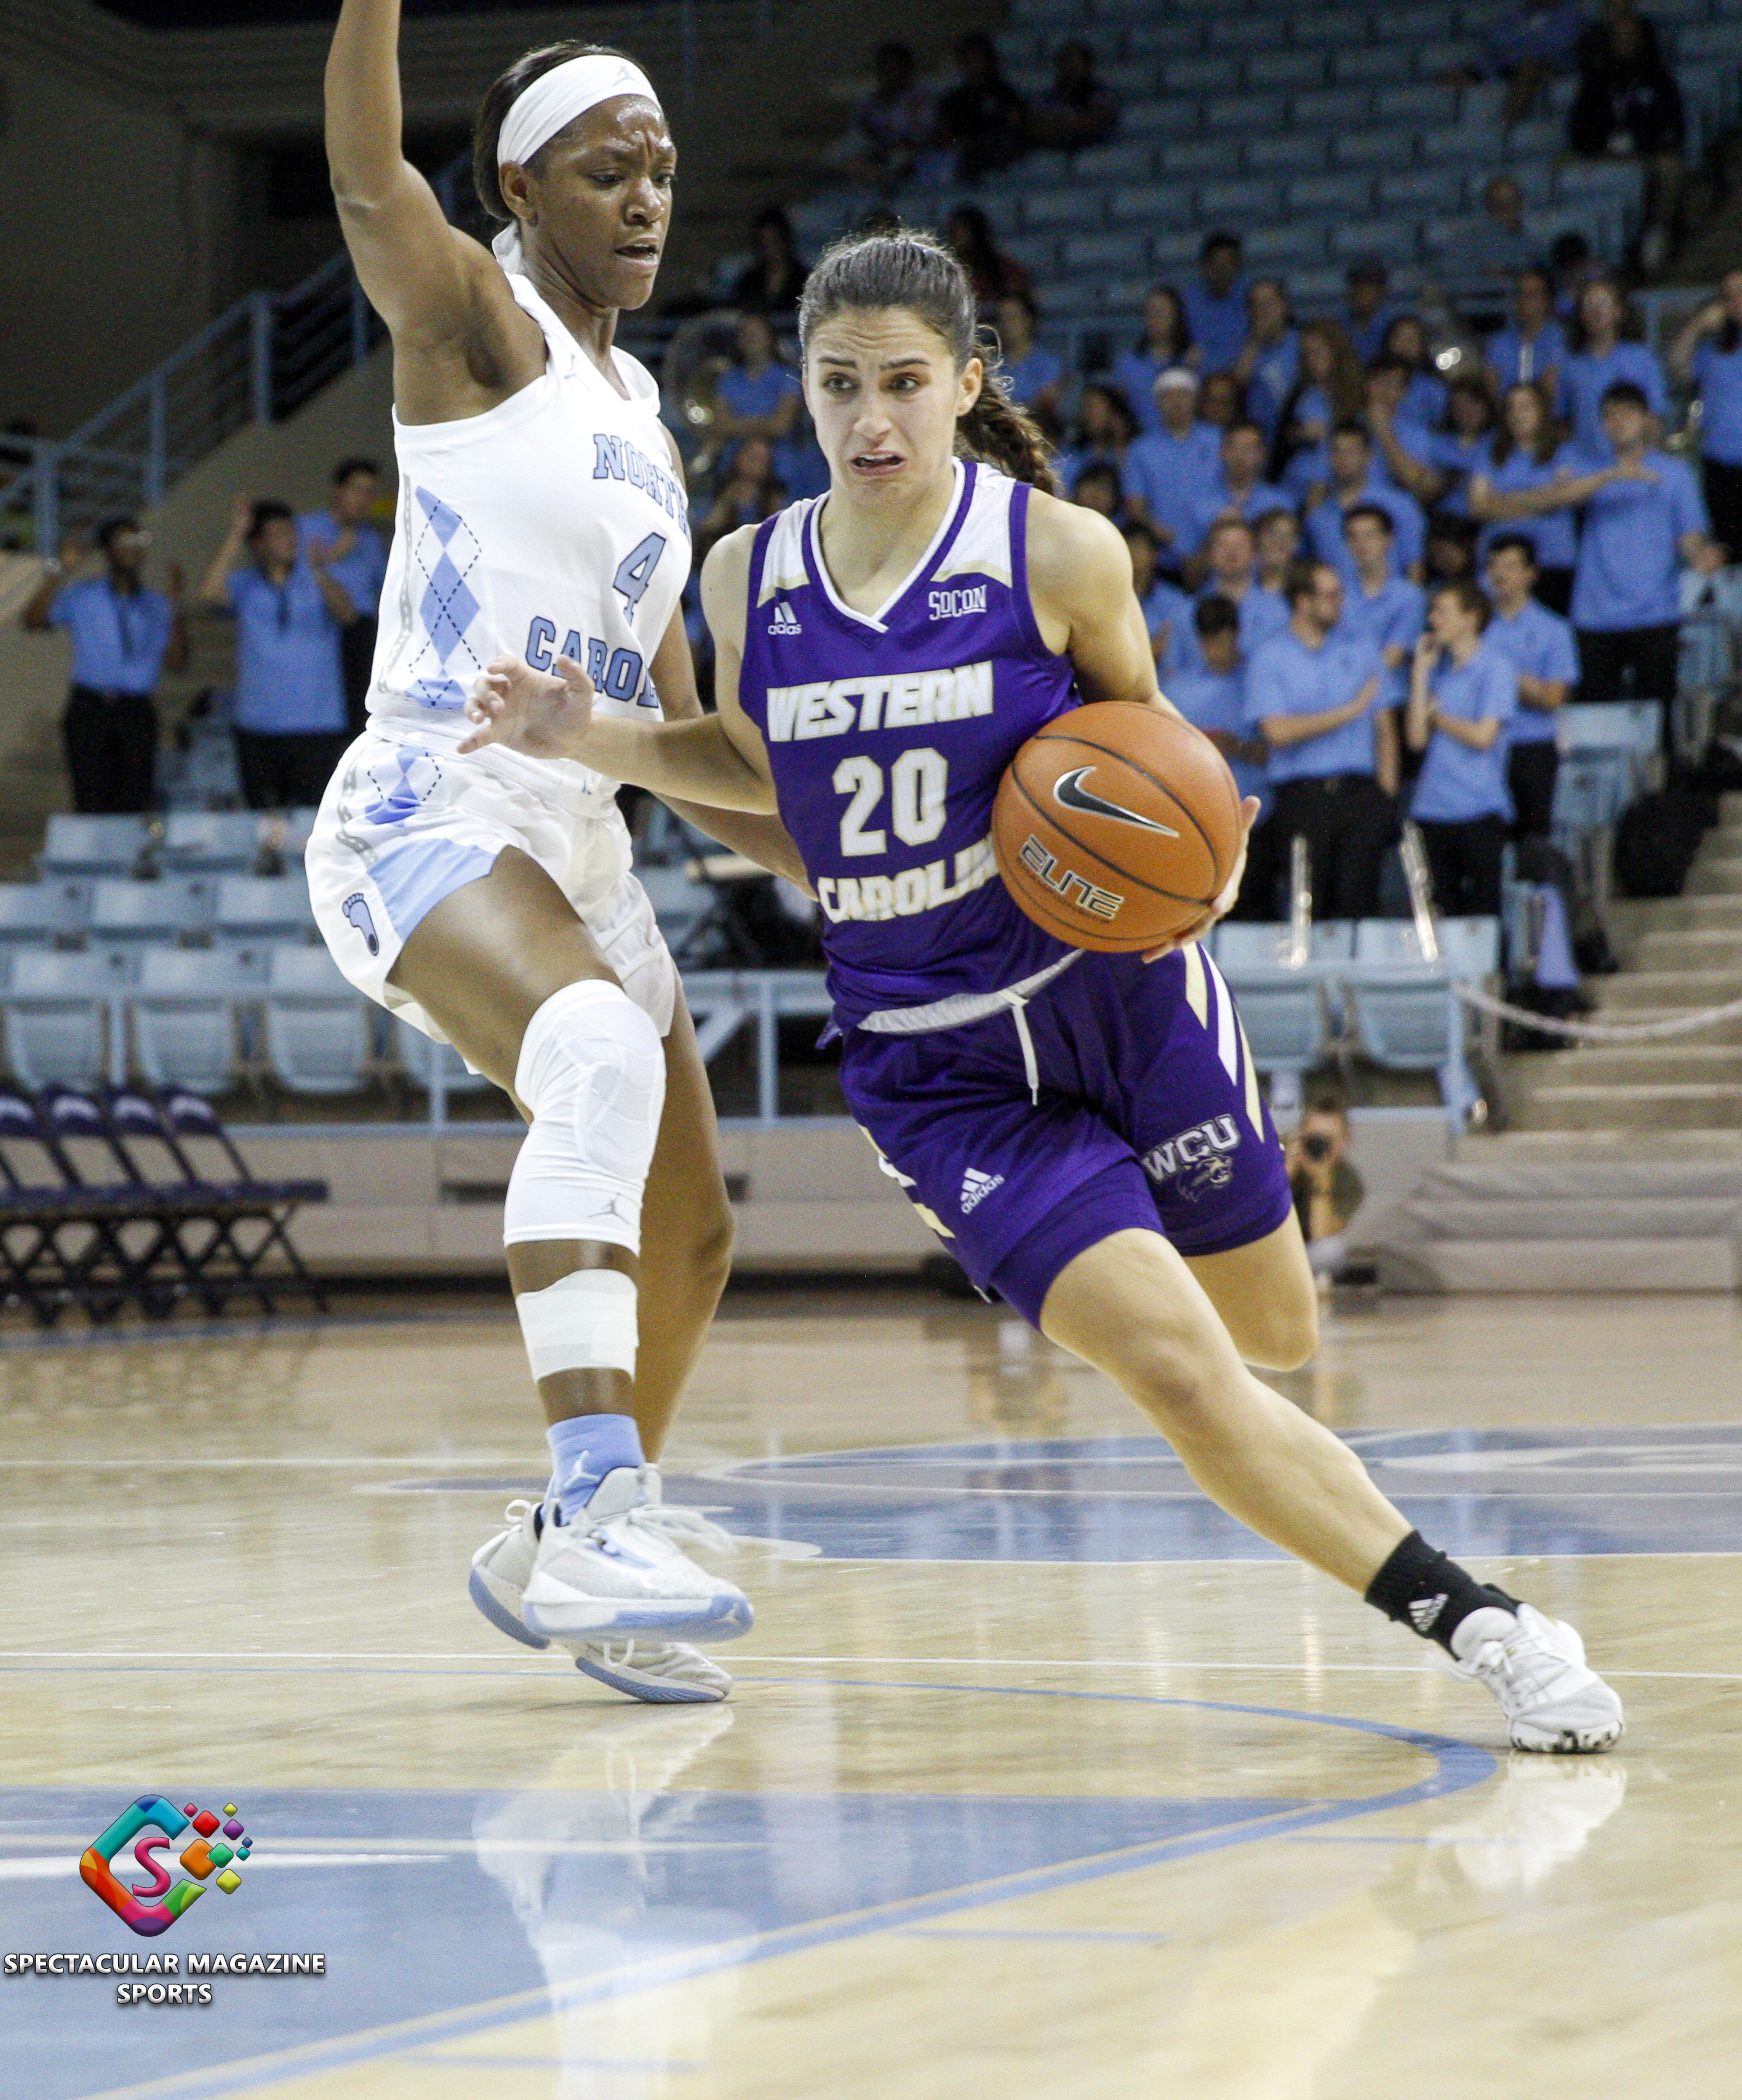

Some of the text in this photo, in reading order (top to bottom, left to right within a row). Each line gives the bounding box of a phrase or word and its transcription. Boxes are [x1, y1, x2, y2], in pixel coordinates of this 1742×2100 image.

[613, 532, 666, 627] 4
[928, 584, 988, 621] SOCON
[525, 615, 659, 708] CAROL
[767, 623, 802, 636] adas
[767, 660, 994, 742] WESTERN
[832, 747, 948, 857] 20
[1019, 833, 1125, 920] ELITE
[1140, 1113, 1241, 1184] WCU
[961, 1173, 1005, 1215] adidas
